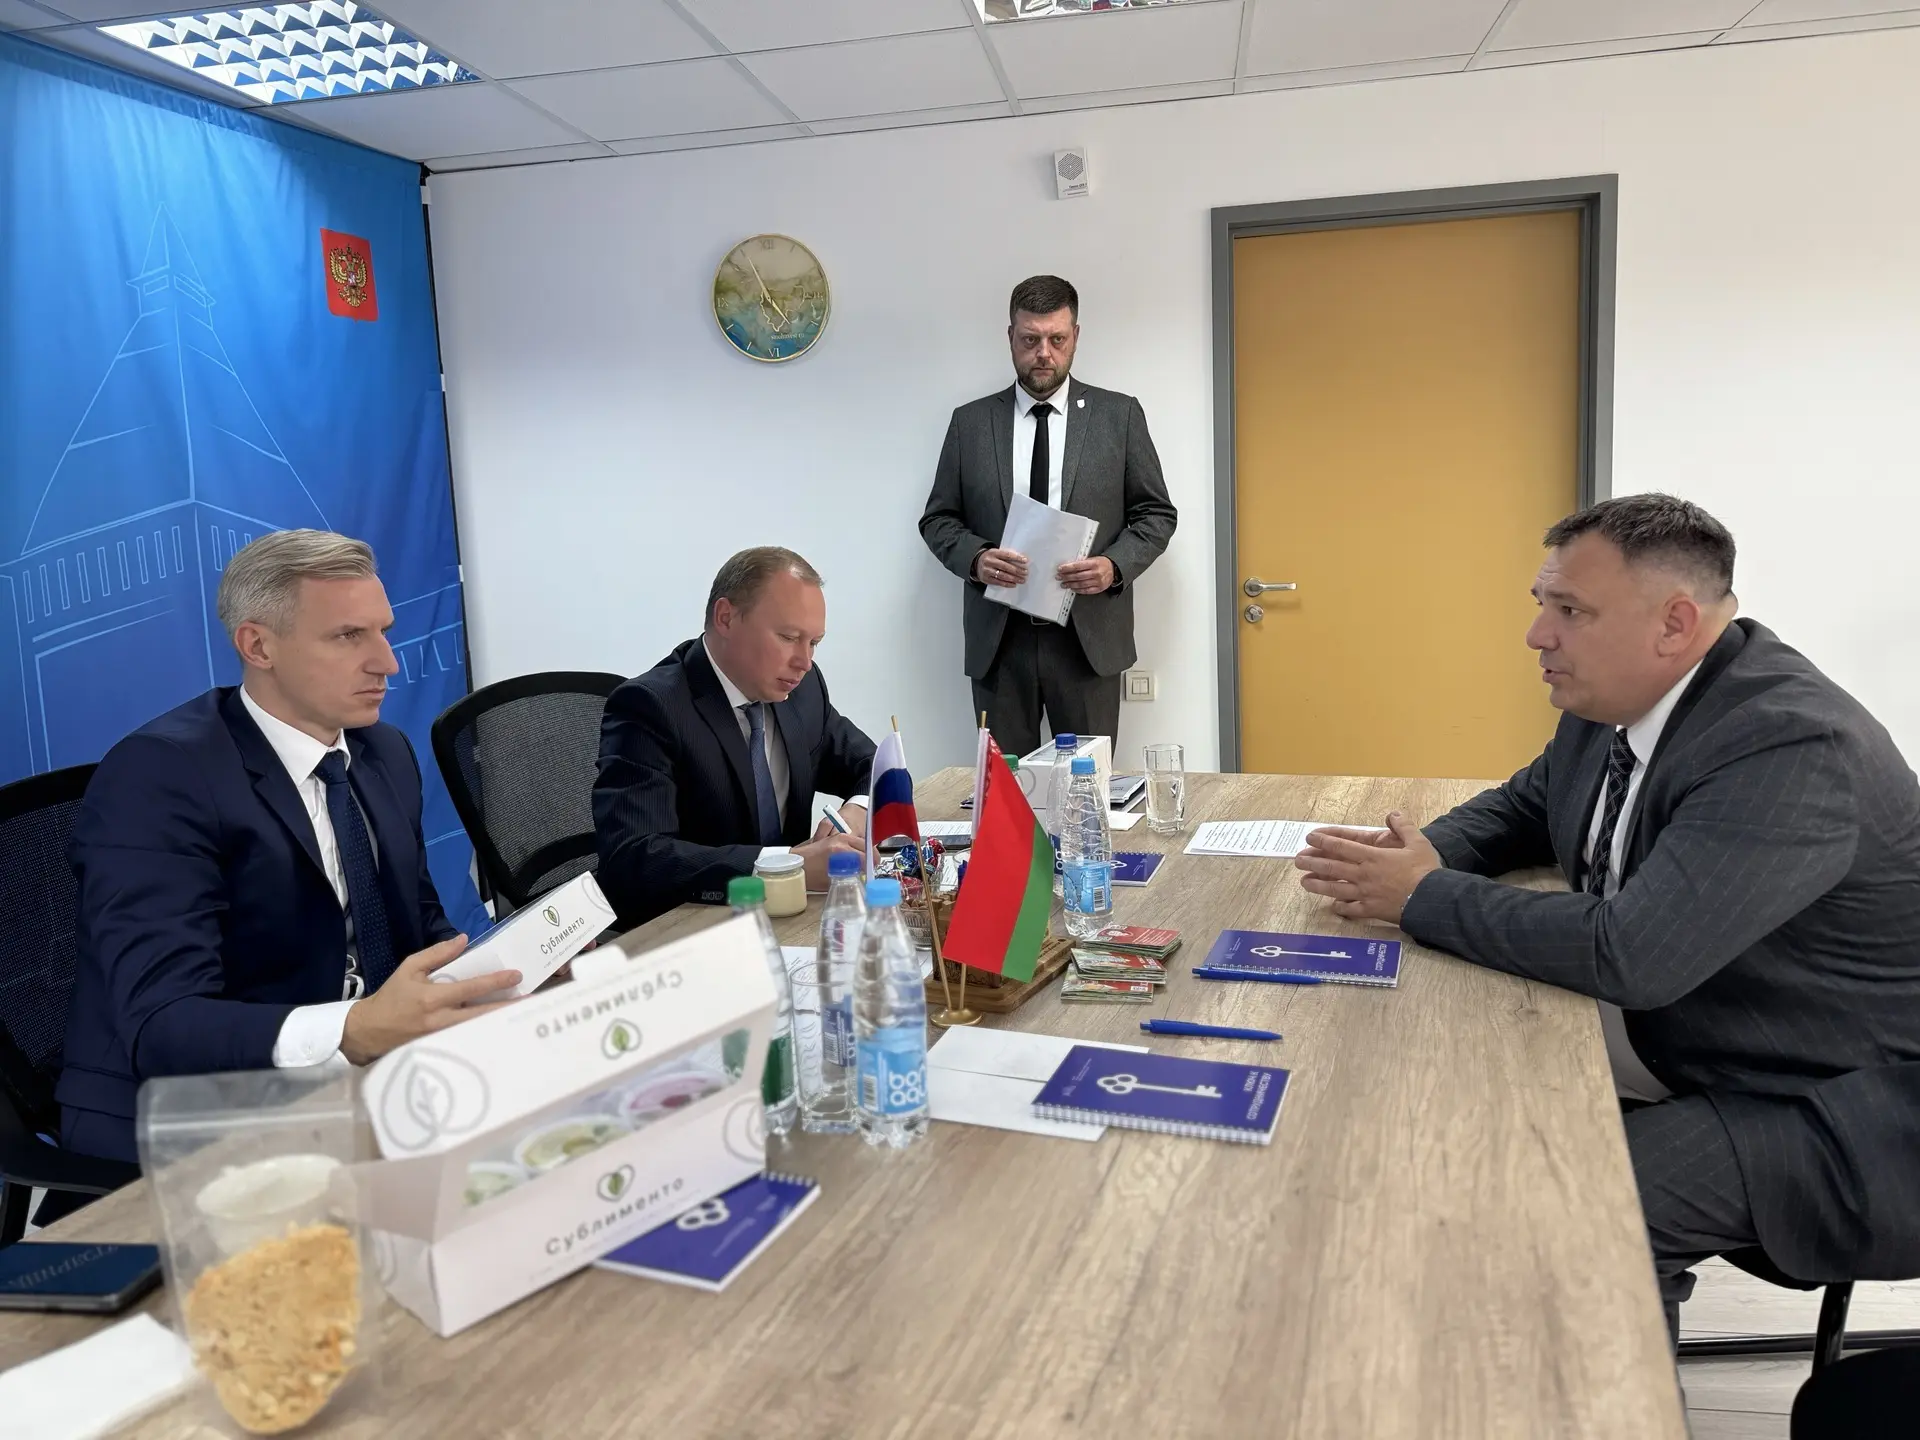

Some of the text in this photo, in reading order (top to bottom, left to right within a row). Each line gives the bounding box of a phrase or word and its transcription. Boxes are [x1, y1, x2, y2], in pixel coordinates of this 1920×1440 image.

[768, 347, 780, 358] VI
[540, 917, 585, 955] Сублименто
[536, 970, 683, 1039] Сублименто
[545, 1177, 684, 1256] Сублименто
